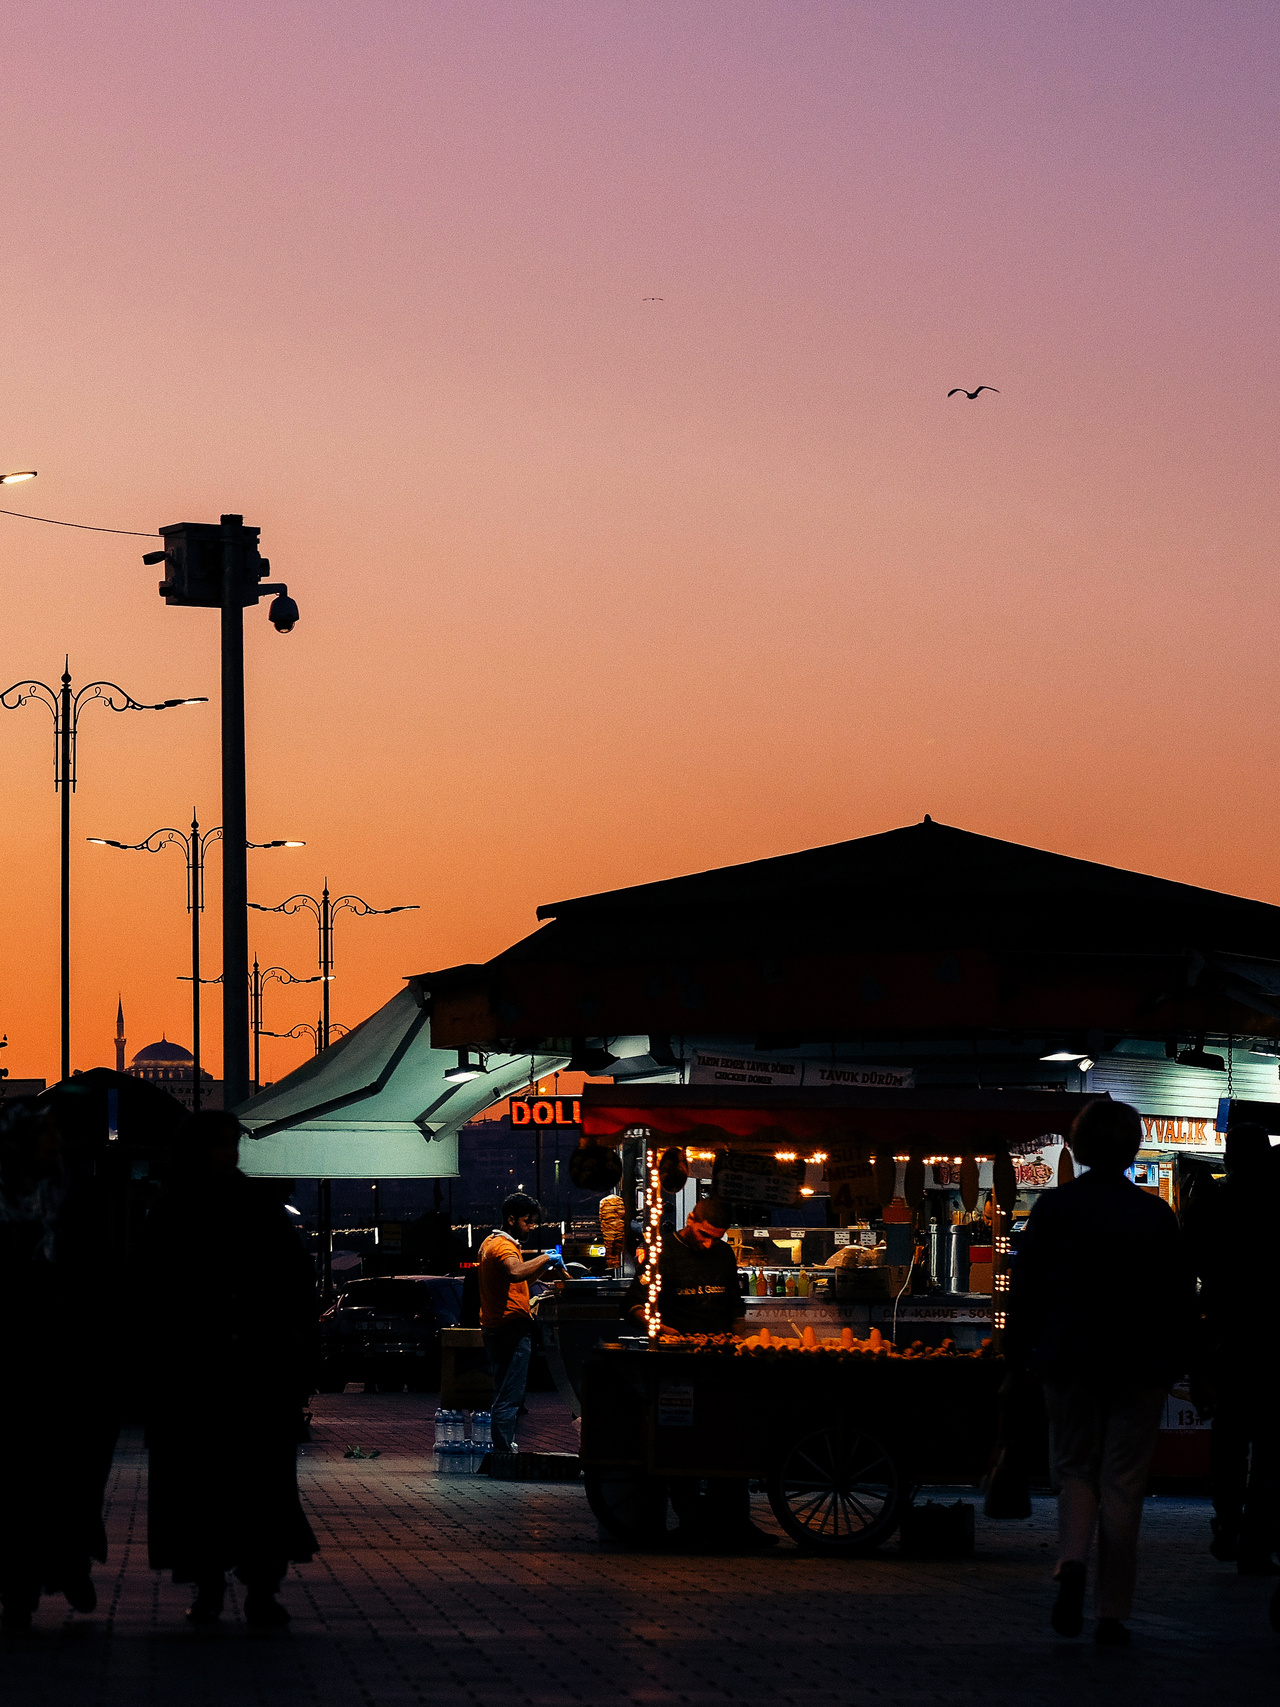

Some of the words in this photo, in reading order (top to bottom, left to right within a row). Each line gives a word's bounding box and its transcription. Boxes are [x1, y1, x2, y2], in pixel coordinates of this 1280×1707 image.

[720, 1057, 745, 1069] EKMEK
[746, 1060, 771, 1072] TAVUK
[715, 1071, 746, 1083] CHICKEN
[819, 1068, 859, 1083] TAVUK
[861, 1071, 904, 1087] DÜRÜM
[1141, 1117, 1207, 1145] YVALIK
[833, 1183, 854, 1208] 4
[697, 1285, 704, 1294] &
[1177, 1409, 1195, 1426] 13
